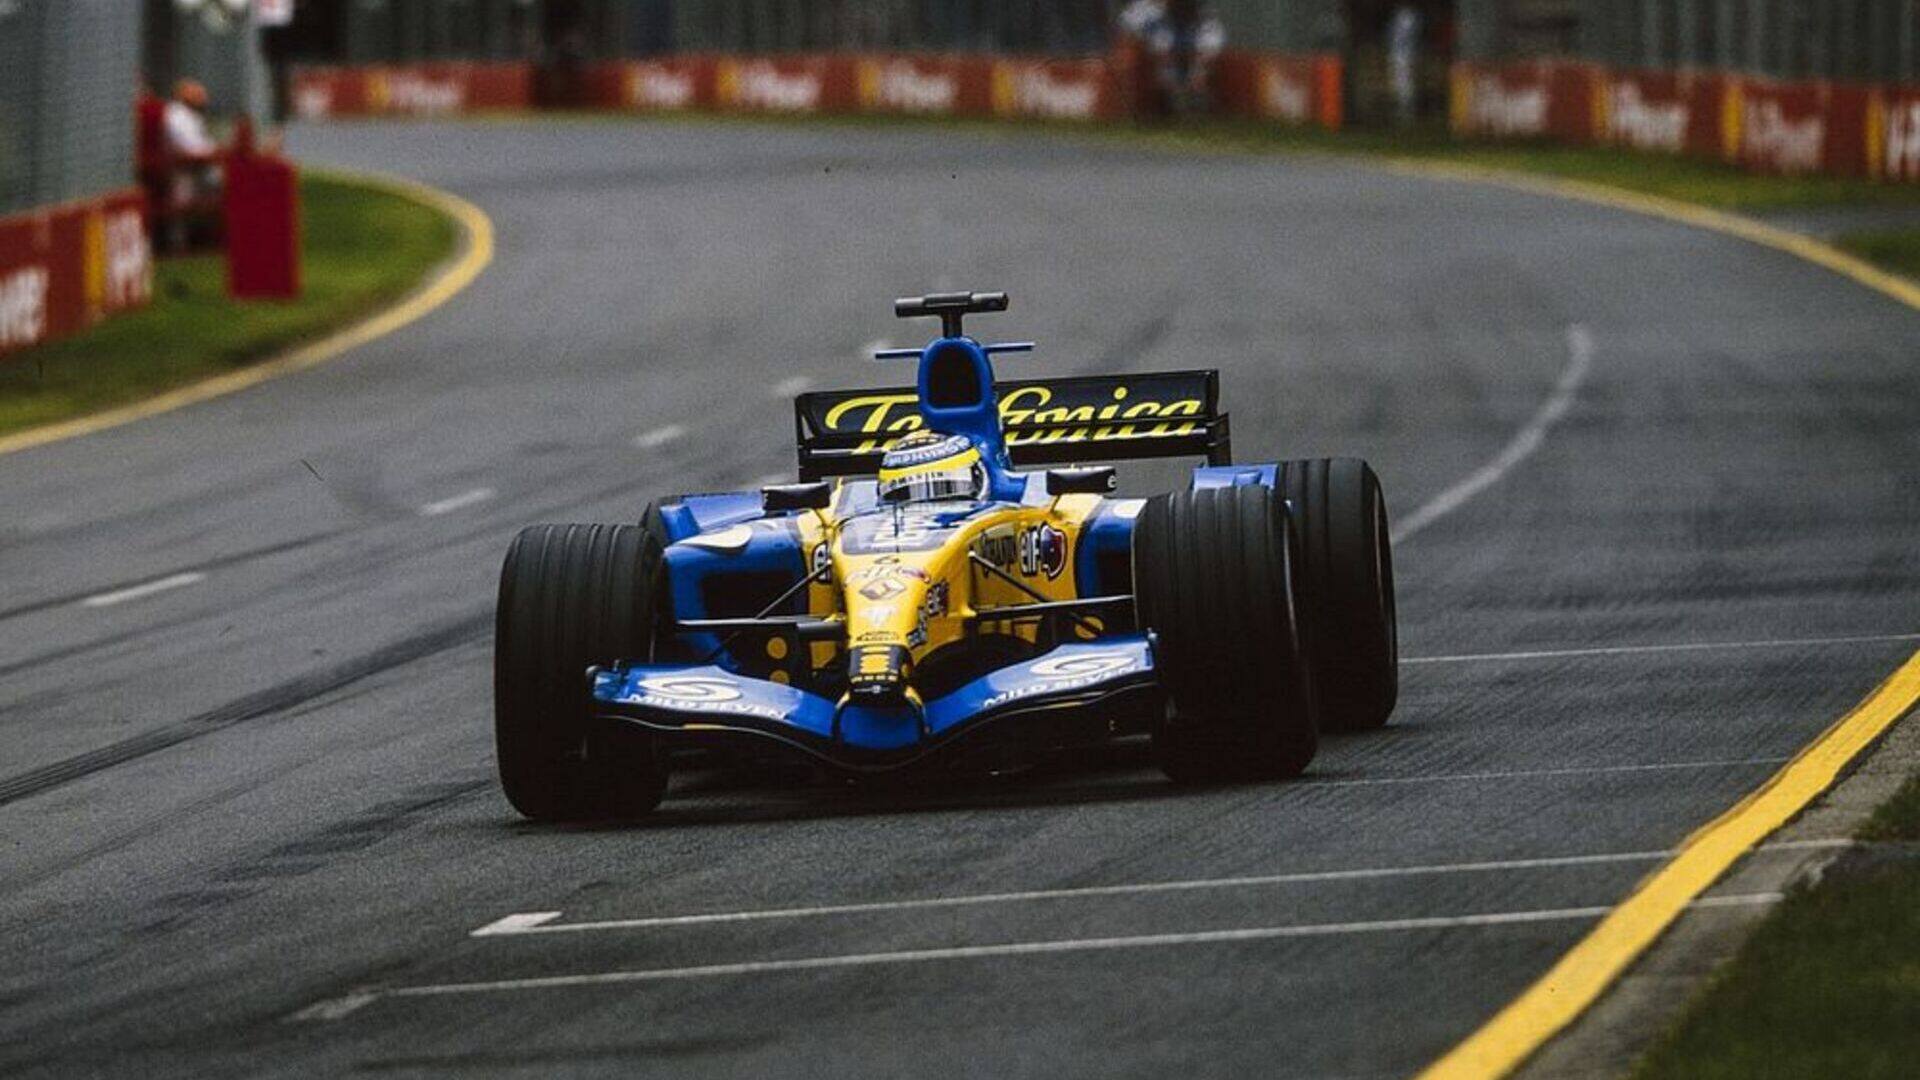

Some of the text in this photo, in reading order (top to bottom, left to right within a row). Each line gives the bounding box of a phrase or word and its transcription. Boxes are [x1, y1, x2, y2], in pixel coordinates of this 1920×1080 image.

[629, 693, 786, 720] MILD SEVEN
[983, 684, 1048, 708] MILD
